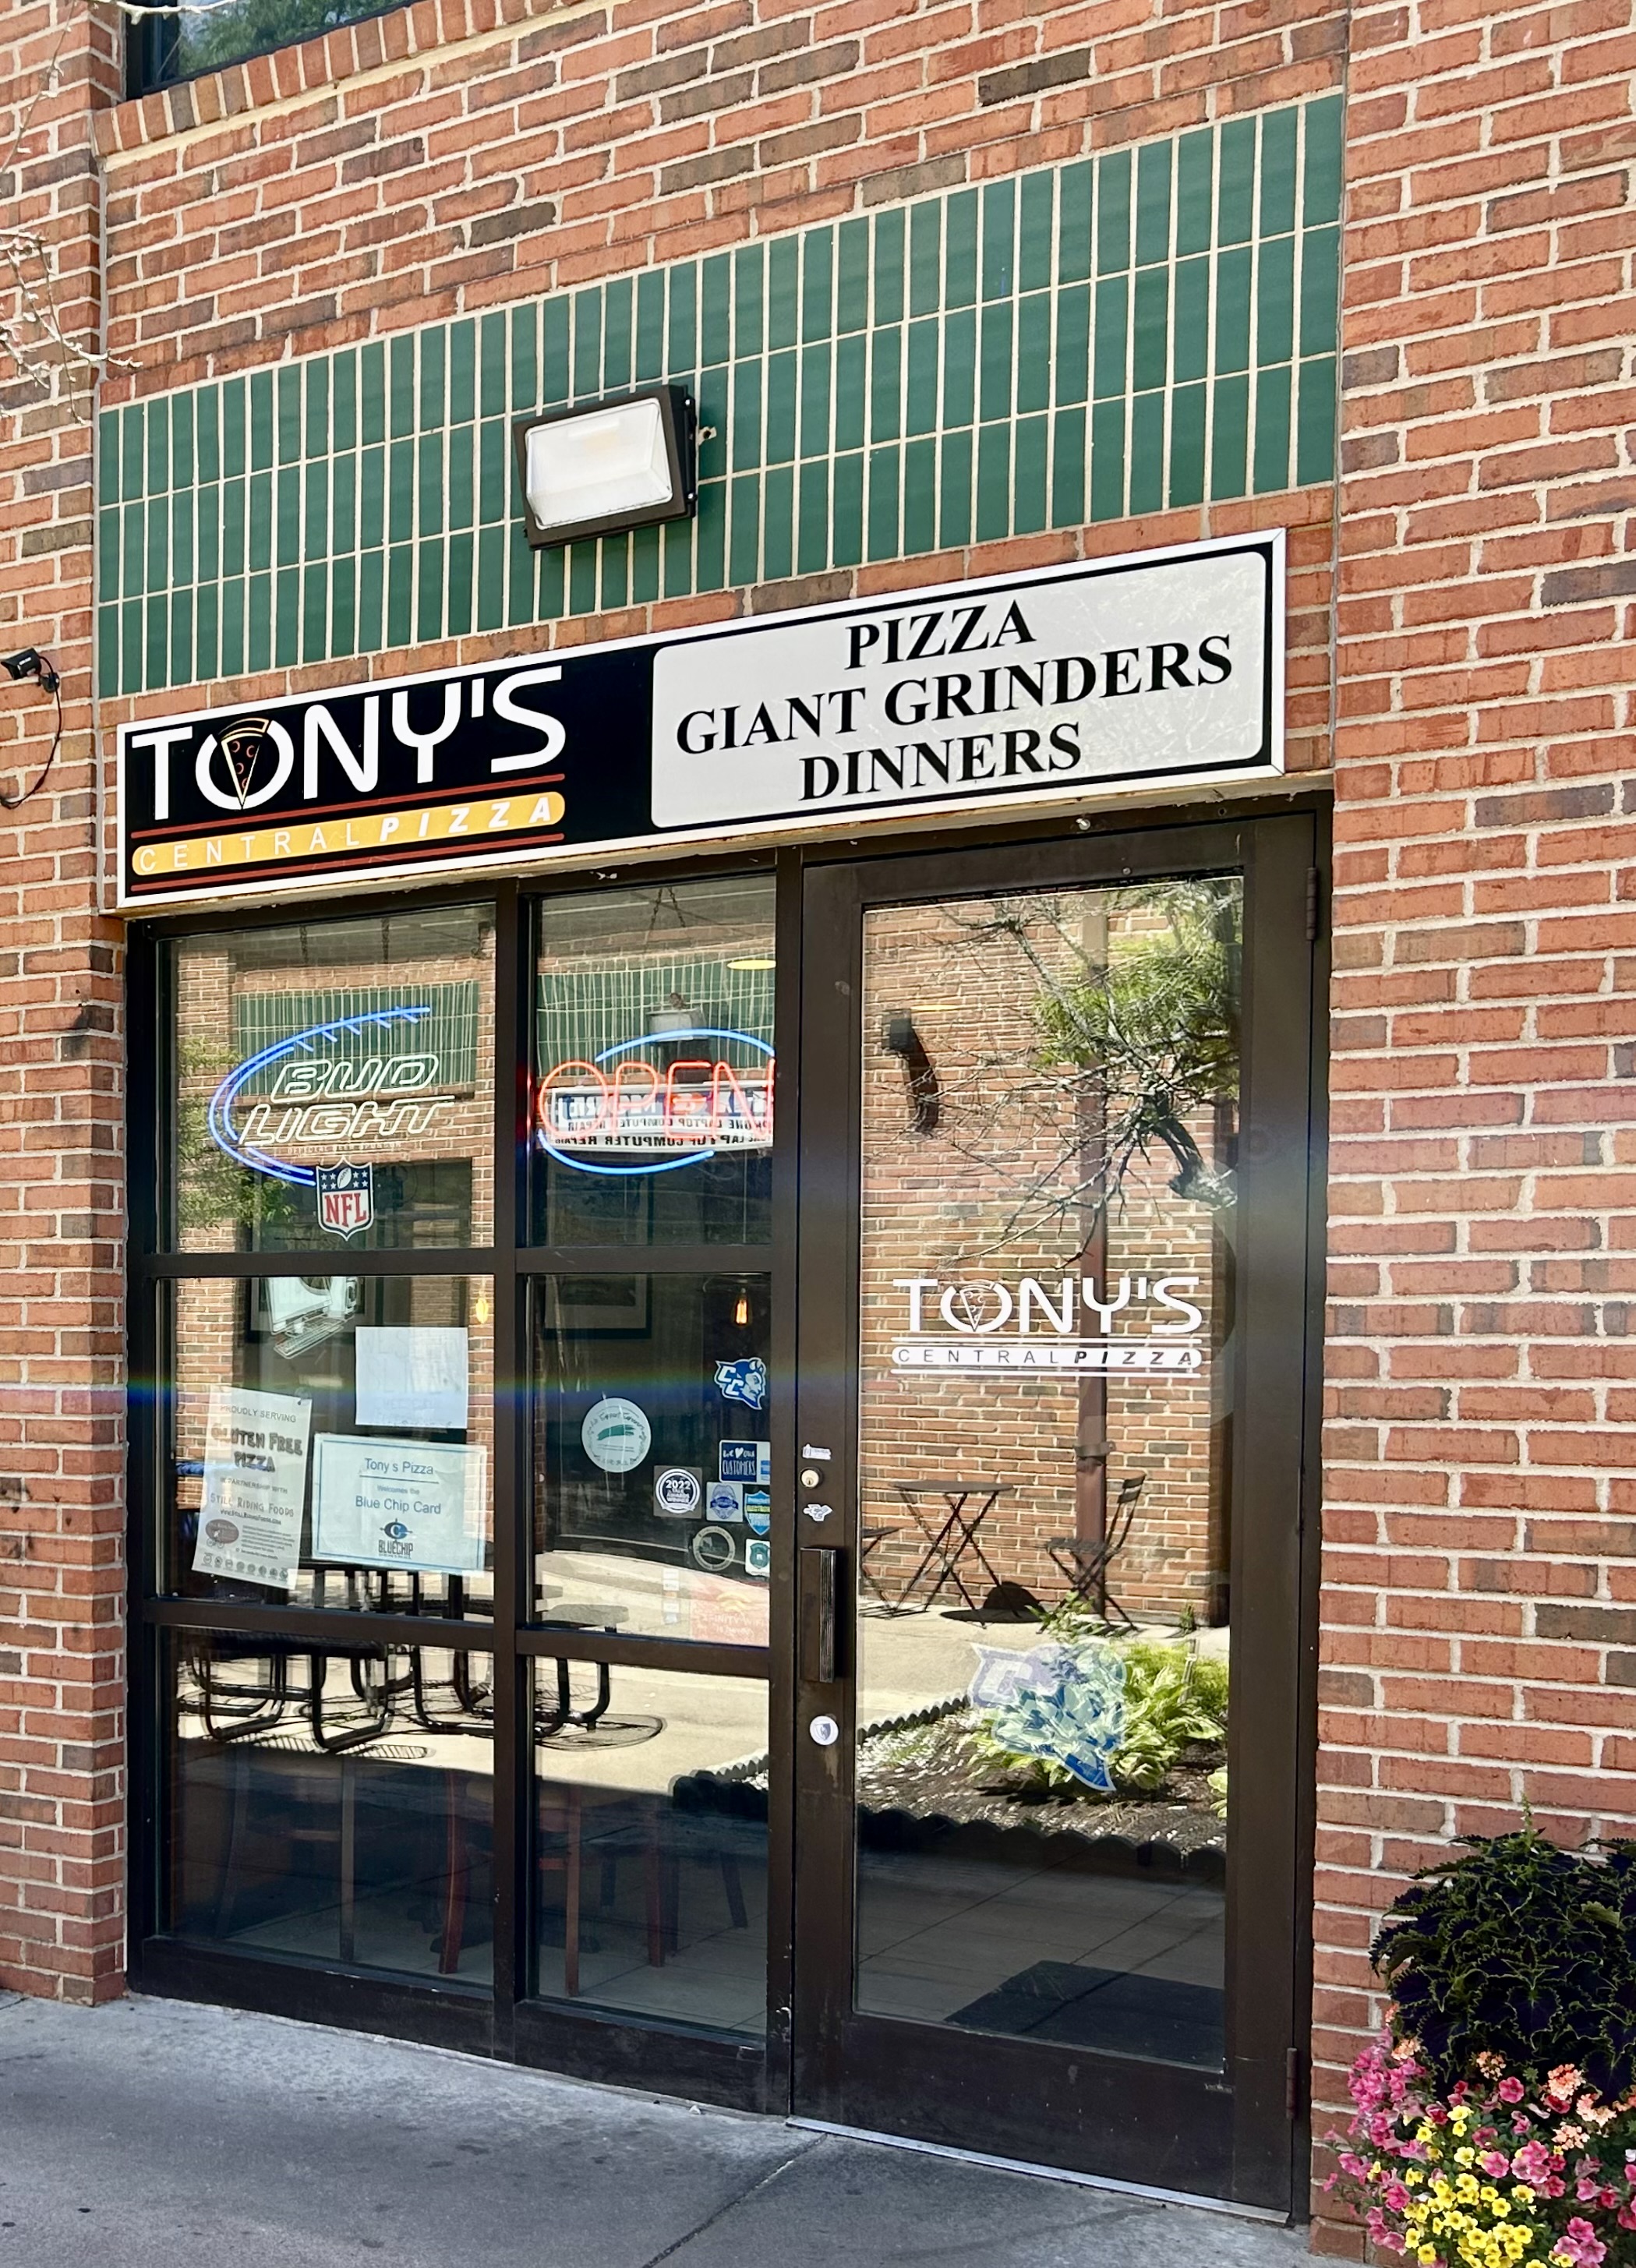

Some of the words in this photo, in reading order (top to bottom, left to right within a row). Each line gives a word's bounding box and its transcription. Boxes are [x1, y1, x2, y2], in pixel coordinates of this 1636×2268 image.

[845, 599, 1036, 670] PIZZA
[677, 687, 866, 754] GIANT
[884, 634, 1232, 726] GRINDERS
[131, 665, 566, 821] TONY'S
[799, 722, 1082, 801] DINNERS
[270, 1054, 438, 1104] BUD
[539, 1060, 775, 1139] OPEN
[239, 1095, 455, 1146] LIGHT
[324, 1193, 367, 1228] NFL
[892, 1277, 1203, 1334] TONY'S
[220, 1405, 258, 1417] PROUDLY
[260, 1410, 296, 1423] SERVING
[270, 1432, 302, 1456] FREE
[234, 1451, 275, 1472] PIZZA
[402, 1461, 434, 1475] Pizza
[722, 1460, 756, 1475] CUSTOMERS
[377, 1485, 408, 1494] Welcomes
[665, 1479, 691, 1489] 2022
[237, 1496, 264, 1512] RIDING
[268, 1503, 294, 1517] FOODS
[355, 1495, 380, 1509] Blue
[383, 1498, 409, 1514] Chip
[413, 1501, 441, 1514] Card
